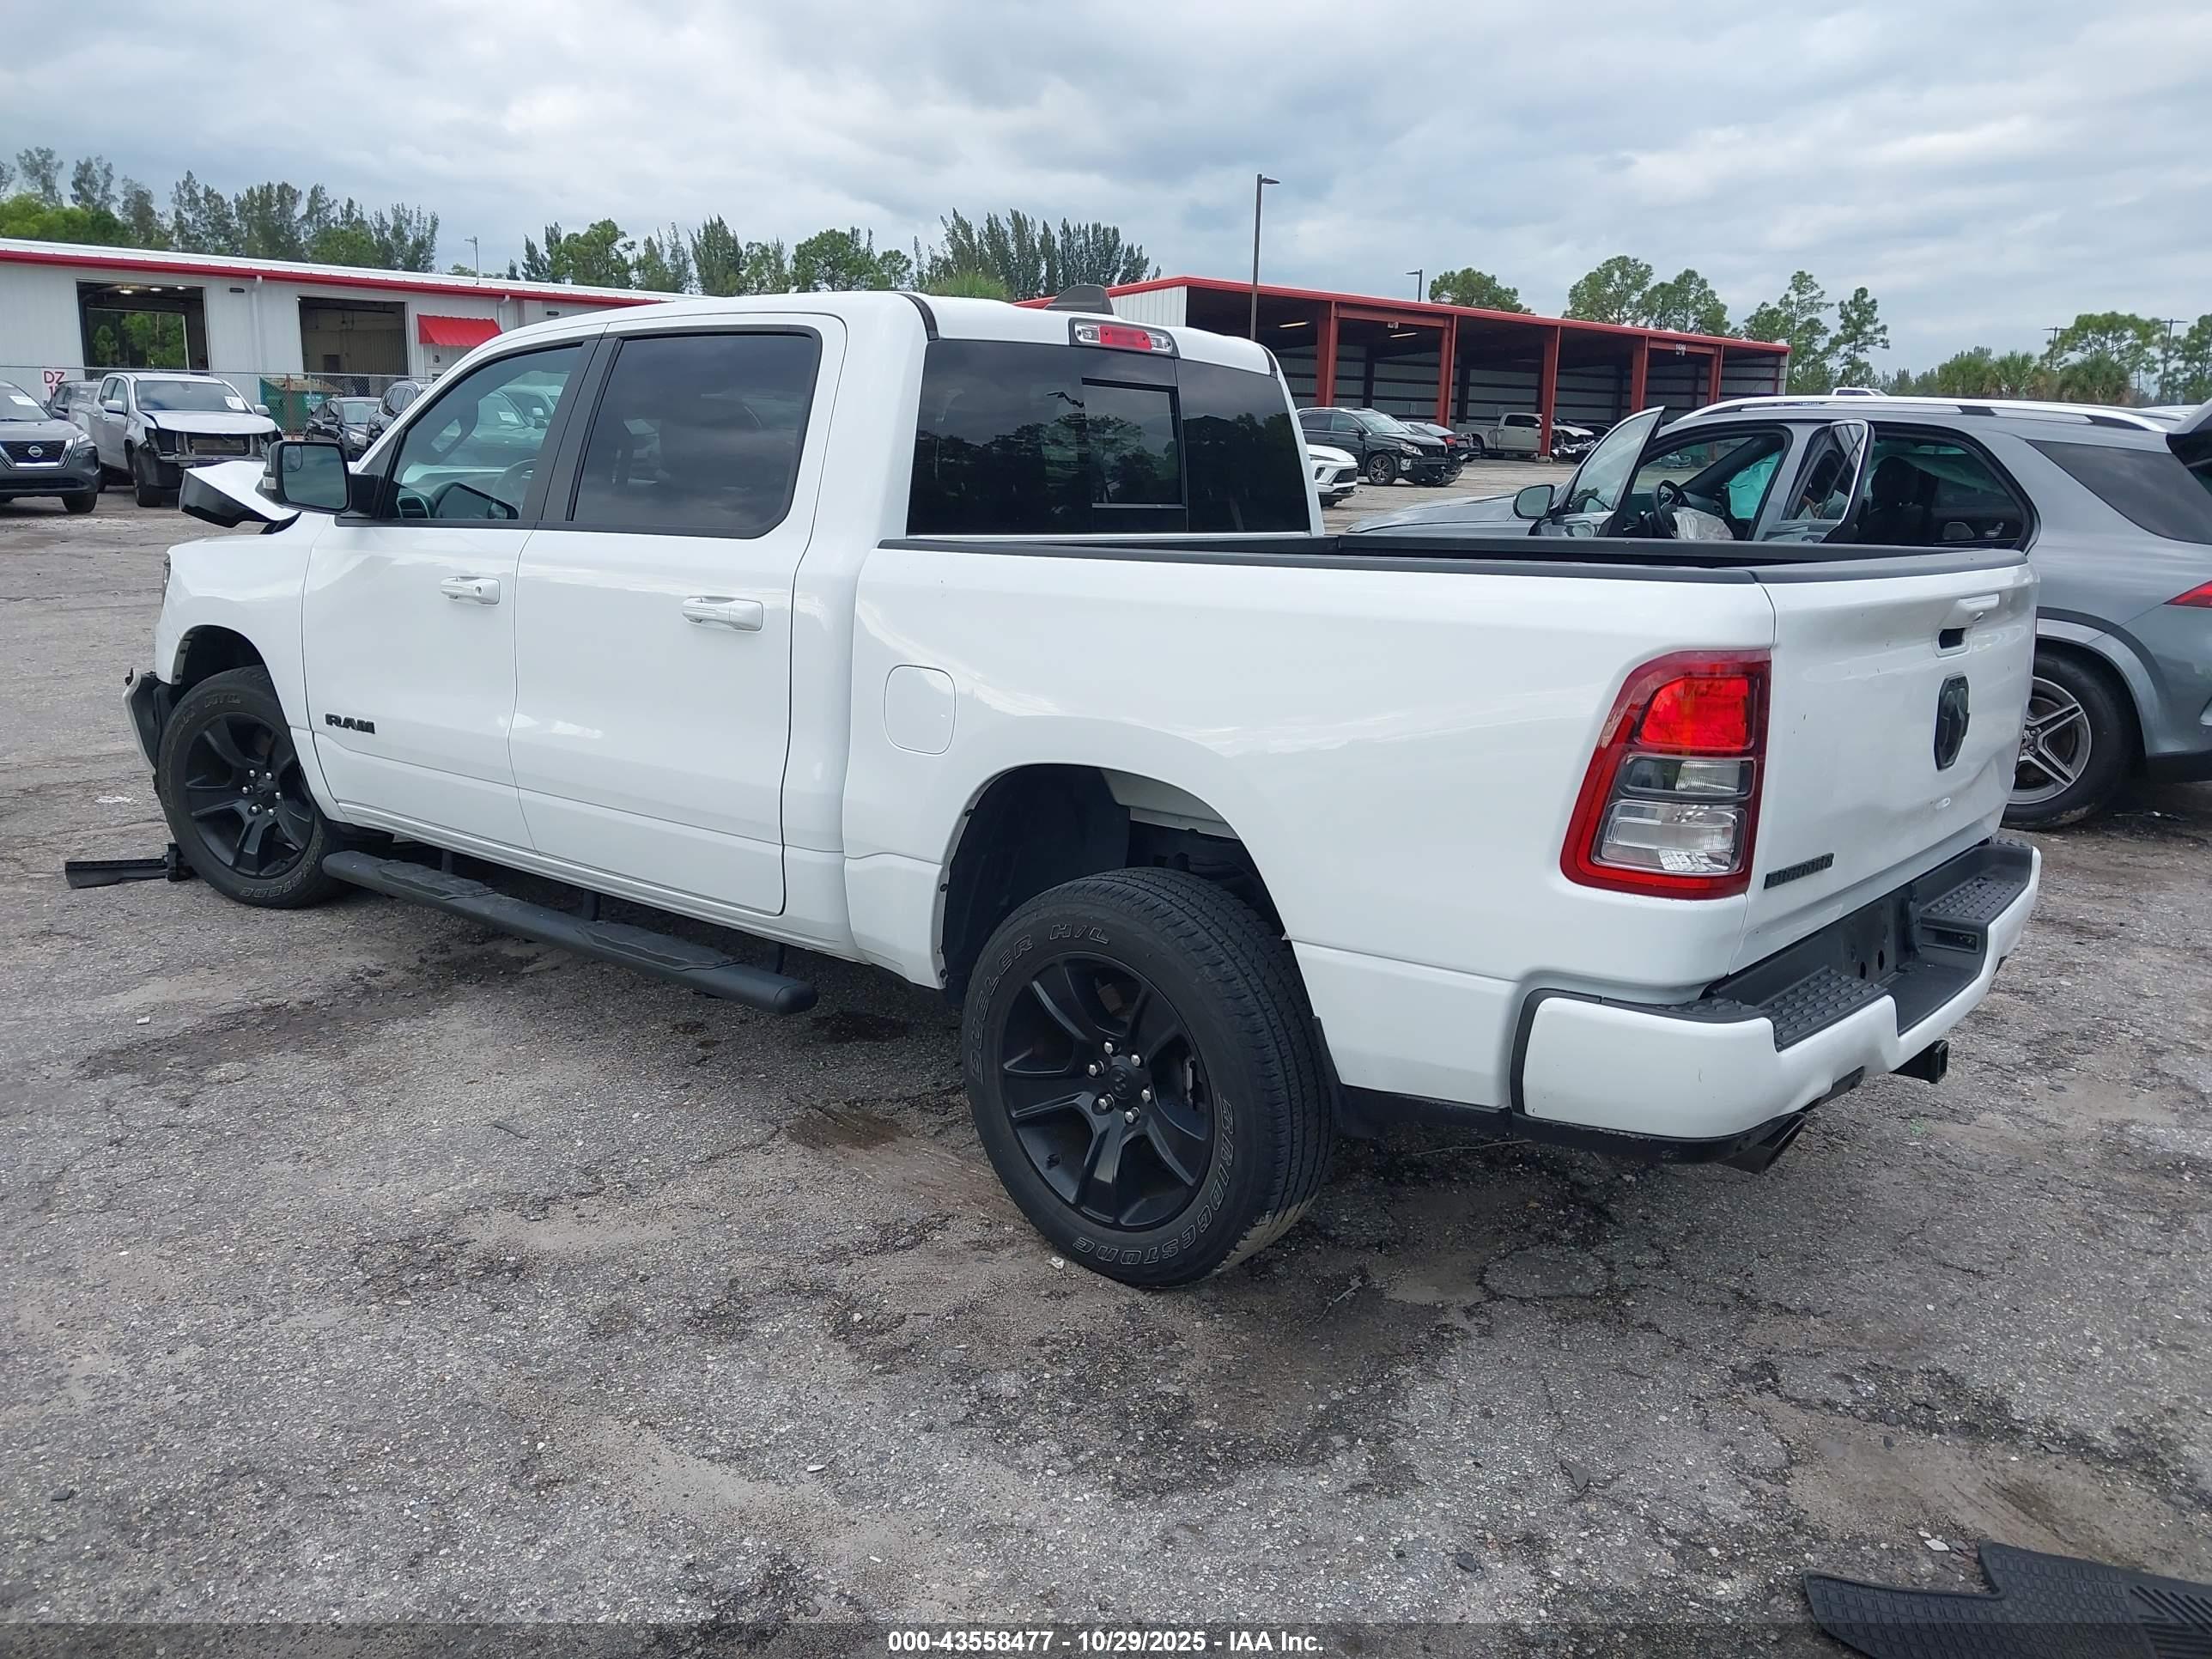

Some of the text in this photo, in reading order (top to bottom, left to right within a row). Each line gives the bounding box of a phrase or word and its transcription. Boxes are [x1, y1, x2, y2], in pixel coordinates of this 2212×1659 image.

[43, 370, 65, 384] DZ
[325, 713, 376, 735] RAM
[970, 923, 1110, 1086] DUELER H/L
[1072, 1091, 1235, 1265] BRIDGESTONE
